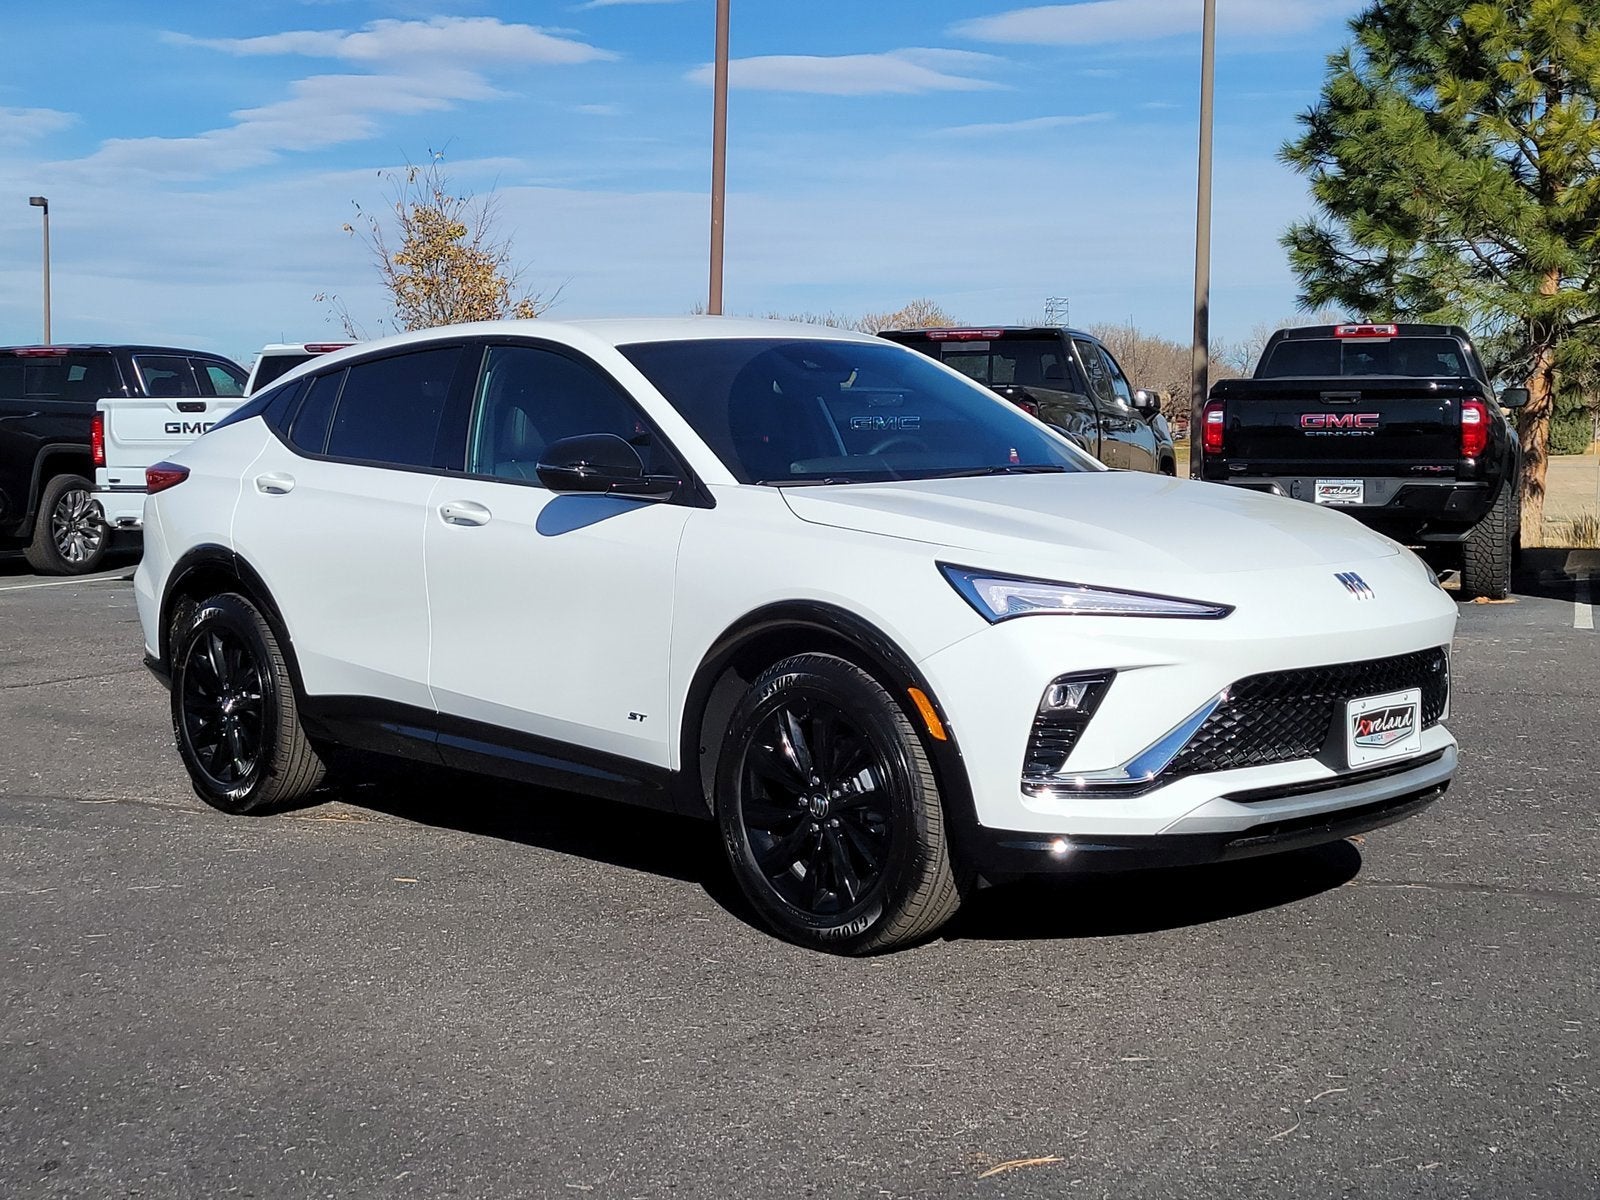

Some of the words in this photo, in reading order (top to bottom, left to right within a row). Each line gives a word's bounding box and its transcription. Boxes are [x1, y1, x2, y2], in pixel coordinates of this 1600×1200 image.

[850, 416, 920, 430] GMC
[1301, 413, 1379, 428] GMC
[628, 712, 648, 722] ST
